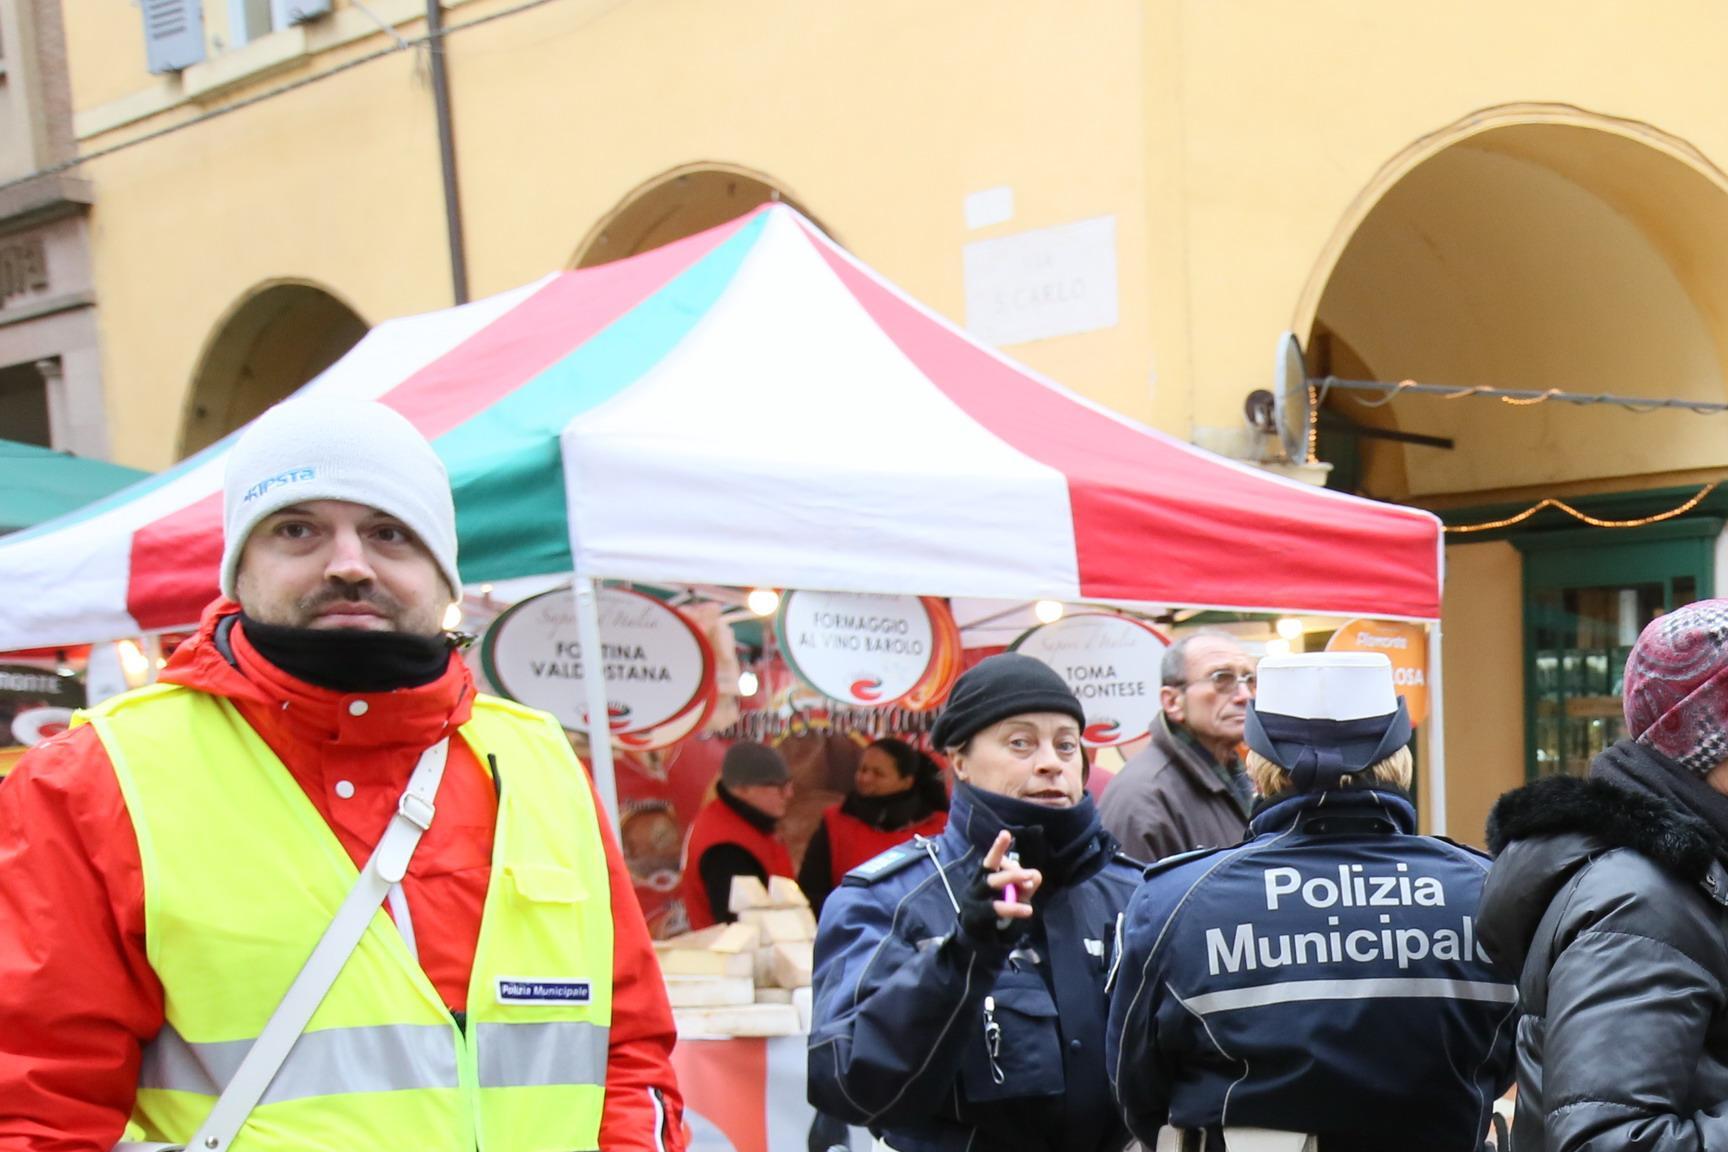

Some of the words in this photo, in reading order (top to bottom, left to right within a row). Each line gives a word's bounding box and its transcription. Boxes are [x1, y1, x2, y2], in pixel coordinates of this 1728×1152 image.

[813, 611, 909, 635] FORMAGGIO
[555, 641, 647, 661] FOTINA
[824, 634, 861, 651] VINO
[865, 636, 923, 655] BAROLO
[530, 660, 672, 682] VALDSTANA
[1066, 665, 1117, 682] TOMA
[1264, 863, 1446, 911] Polizia
[503, 984, 532, 996] Polizia
[533, 985, 588, 998] Municipale
